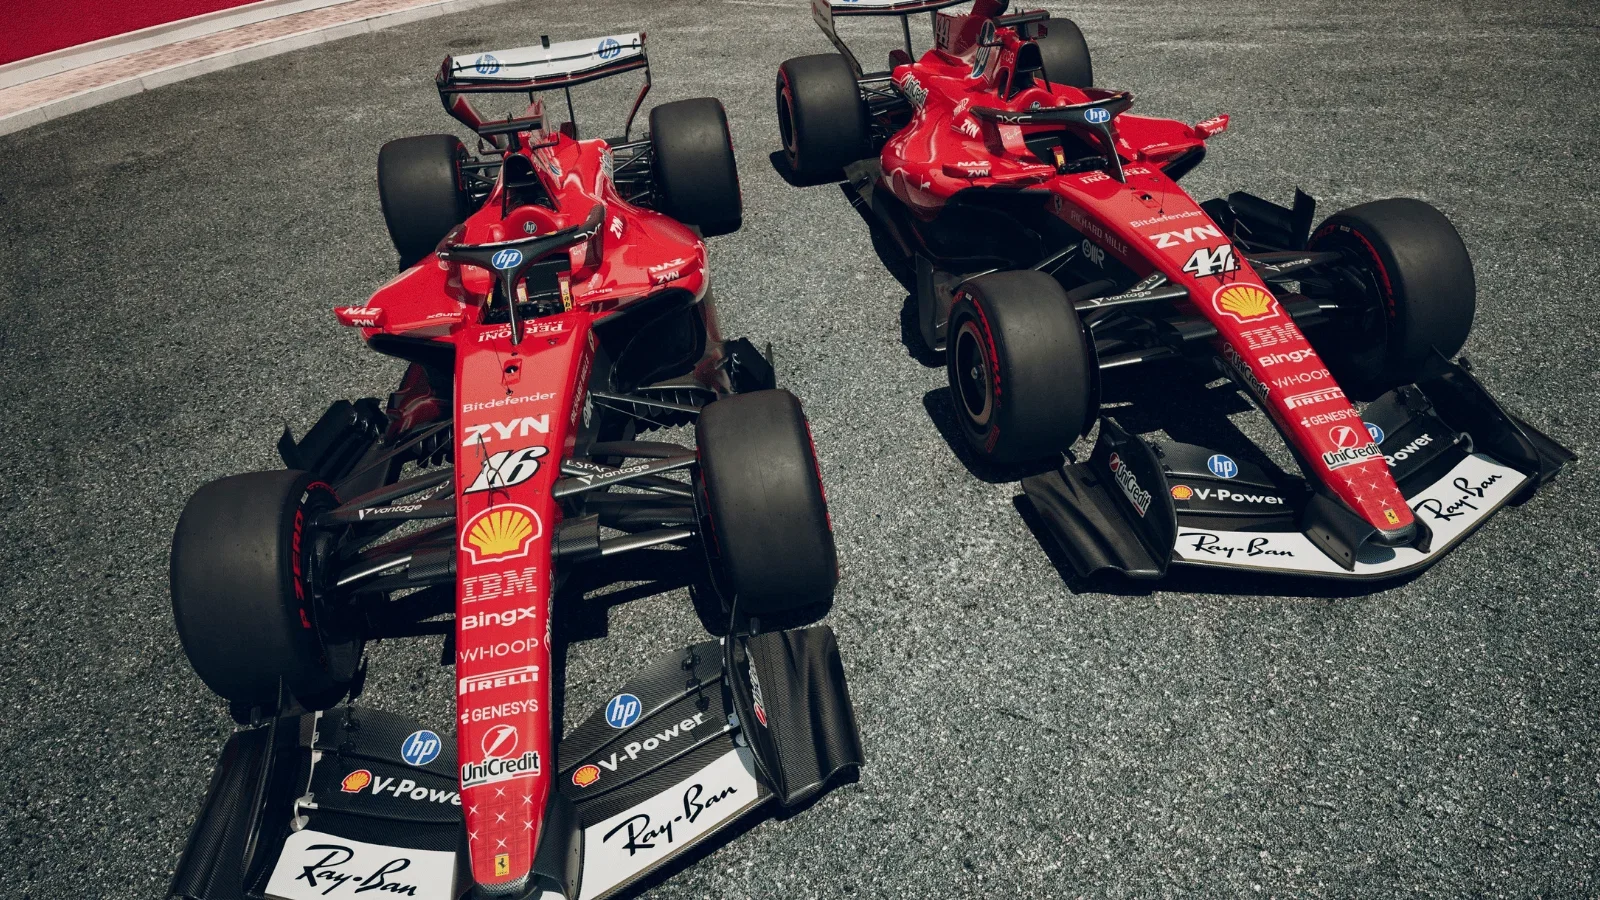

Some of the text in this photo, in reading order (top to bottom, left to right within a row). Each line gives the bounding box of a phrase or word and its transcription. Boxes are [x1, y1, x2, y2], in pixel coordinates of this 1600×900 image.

[600, 38, 620, 60] hp
[1089, 108, 1107, 123] hp
[960, 119, 979, 138] ZYN
[1130, 209, 1203, 229] Bitdefender
[1149, 224, 1223, 249] ZYN
[495, 249, 518, 268] hp
[1182, 244, 1241, 278] 44
[1106, 290, 1152, 301] vantage
[478, 323, 564, 342] PERONI
[1240, 323, 1304, 350] IBM
[1258, 348, 1317, 367] Bingx
[1231, 350, 1271, 401] UniCredit
[1272, 369, 1330, 388] WHOOP
[463, 391, 557, 413] Bitdefender
[1284, 386, 1346, 410] PIRELLI
[1310, 408, 1358, 426] GENESYS
[462, 414, 550, 447] ZYN
[1213, 454, 1234, 478] hp
[1323, 443, 1382, 466] UniCredit
[463, 446, 550, 496] 16
[597, 464, 650, 479] vantage
[1116, 460, 1153, 514] UniCredit
[1194, 488, 1286, 505] V-Power
[1413, 473, 1503, 522] Ray-Ban
[374, 504, 423, 515] vantage
[1179, 532, 1295, 558] Ray-Ban
[462, 567, 537, 604] IBM
[462, 606, 536, 631] Bingx
[460, 638, 539, 663] WHOOP
[459, 665, 539, 696] PIRELLI
[472, 699, 538, 722] GENESYS
[609, 694, 639, 728] hp
[404, 730, 438, 766] hp
[598, 712, 704, 771] V-Power
[462, 751, 540, 783] UniCredit
[371, 776, 462, 806] V-Powe
[603, 784, 738, 856] Ray-Ban
[295, 844, 418, 896] Ray-Ban
